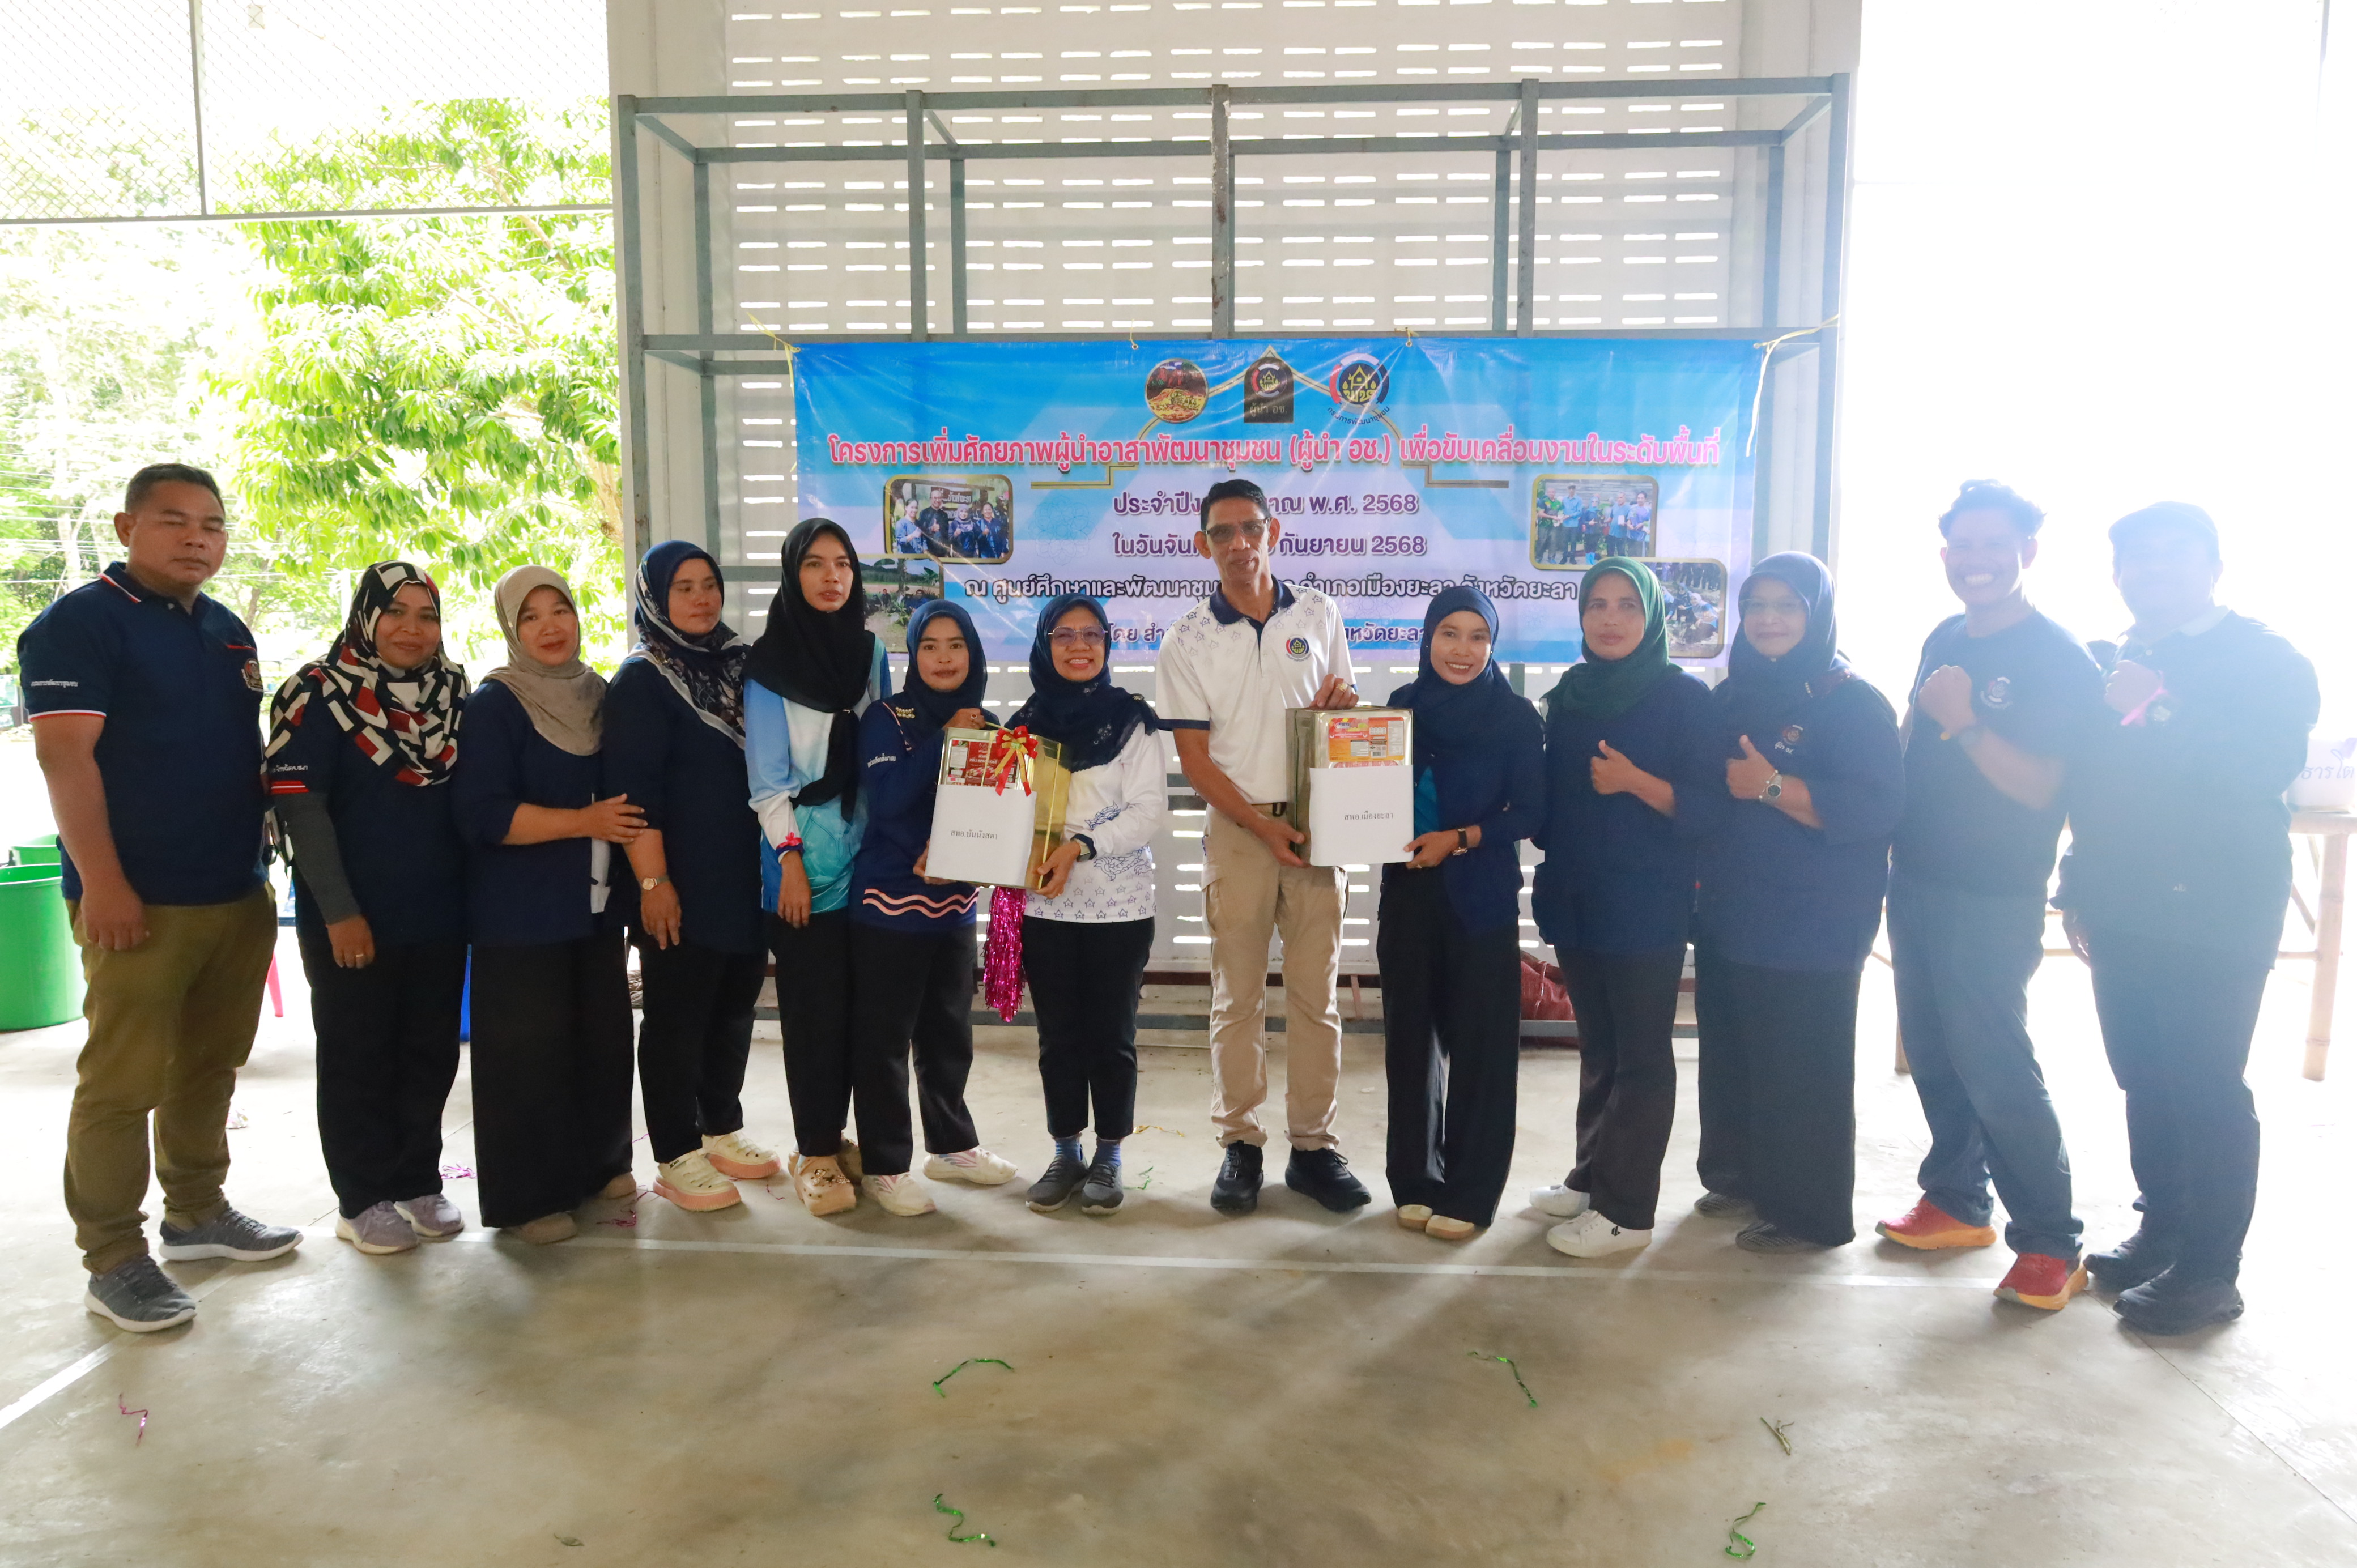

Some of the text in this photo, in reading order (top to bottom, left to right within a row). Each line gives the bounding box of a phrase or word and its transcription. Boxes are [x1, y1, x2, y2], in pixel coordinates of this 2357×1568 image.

[827, 424, 1721, 472] โครงการเพิ่มศักยภาพผู้นำอาสาพัฒนาชุมชน (ผู้นำ อช.) เพื่อขับเคลื่อนงานในระดับพื้นที่
[1308, 494, 1356, 514] พ.ศ.
[1362, 493, 1418, 513] 2568
[1279, 531, 1365, 554] กันยายน
[1371, 535, 1427, 553] 2568
[965, 579, 988, 596] ณ
[1344, 809, 1394, 821] สพอ.เมืองยะลา
[951, 828, 998, 840] สพอ.บันนังสตา
